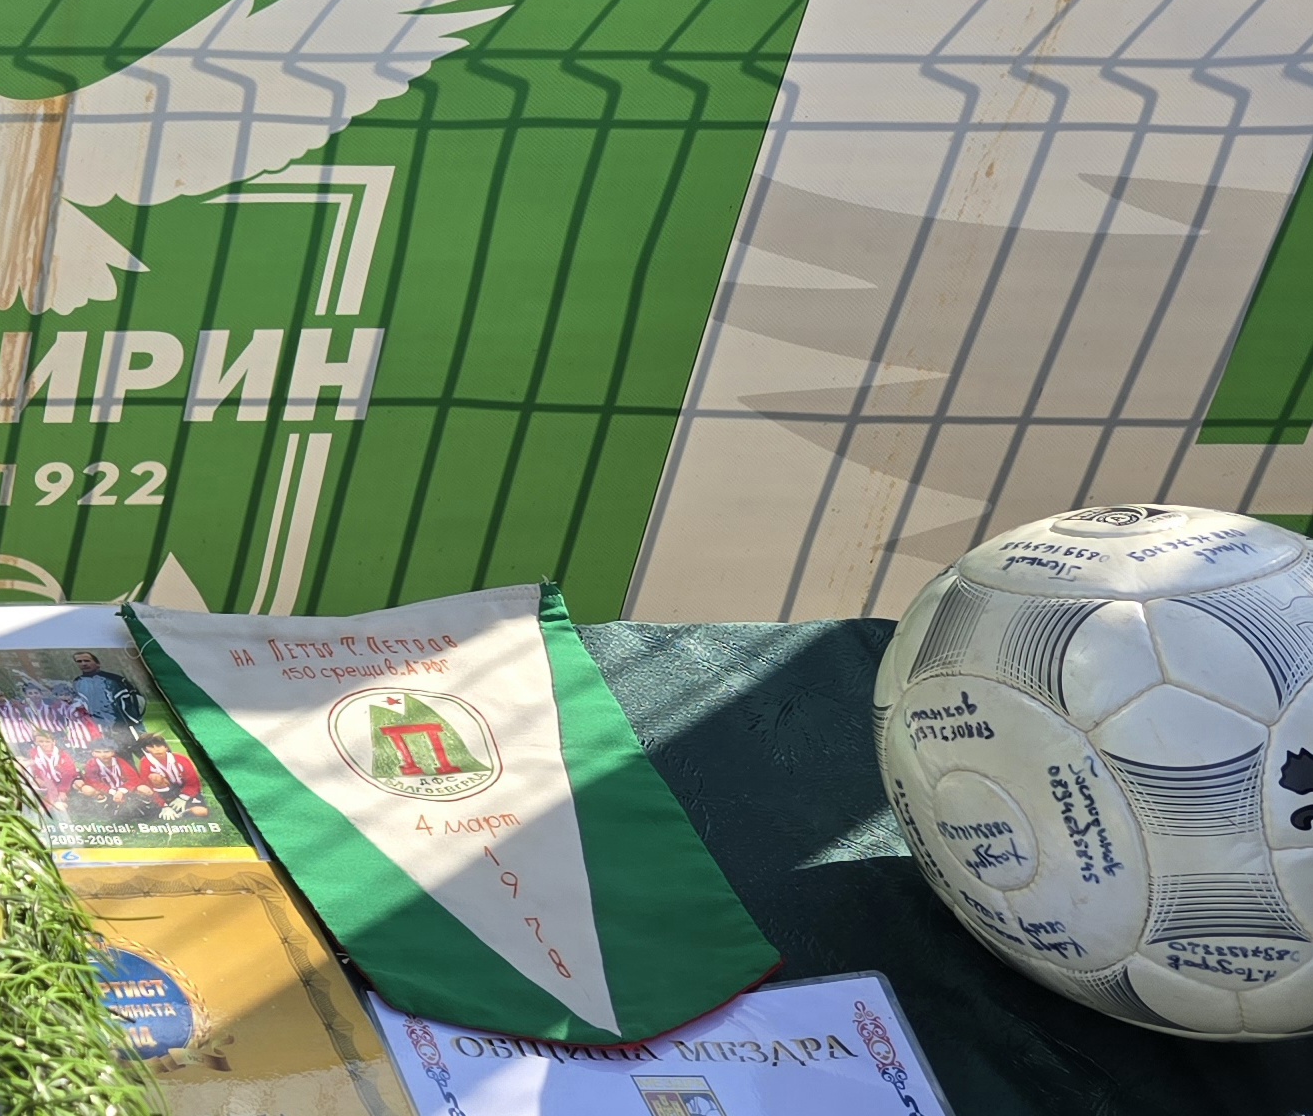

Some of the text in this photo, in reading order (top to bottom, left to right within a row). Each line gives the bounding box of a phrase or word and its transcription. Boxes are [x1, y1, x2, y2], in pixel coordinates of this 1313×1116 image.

[230, 648, 256, 667] НА
[281, 665, 316, 681] 150
[321, 663, 384, 684] срещи
[379, 722, 462, 777] П
[383, 771, 490, 794] БЛАГОЕВГРАД
[419, 775, 458, 787] ДФС
[208, 822, 221, 833] B
[414, 811, 522, 841] 4 март
